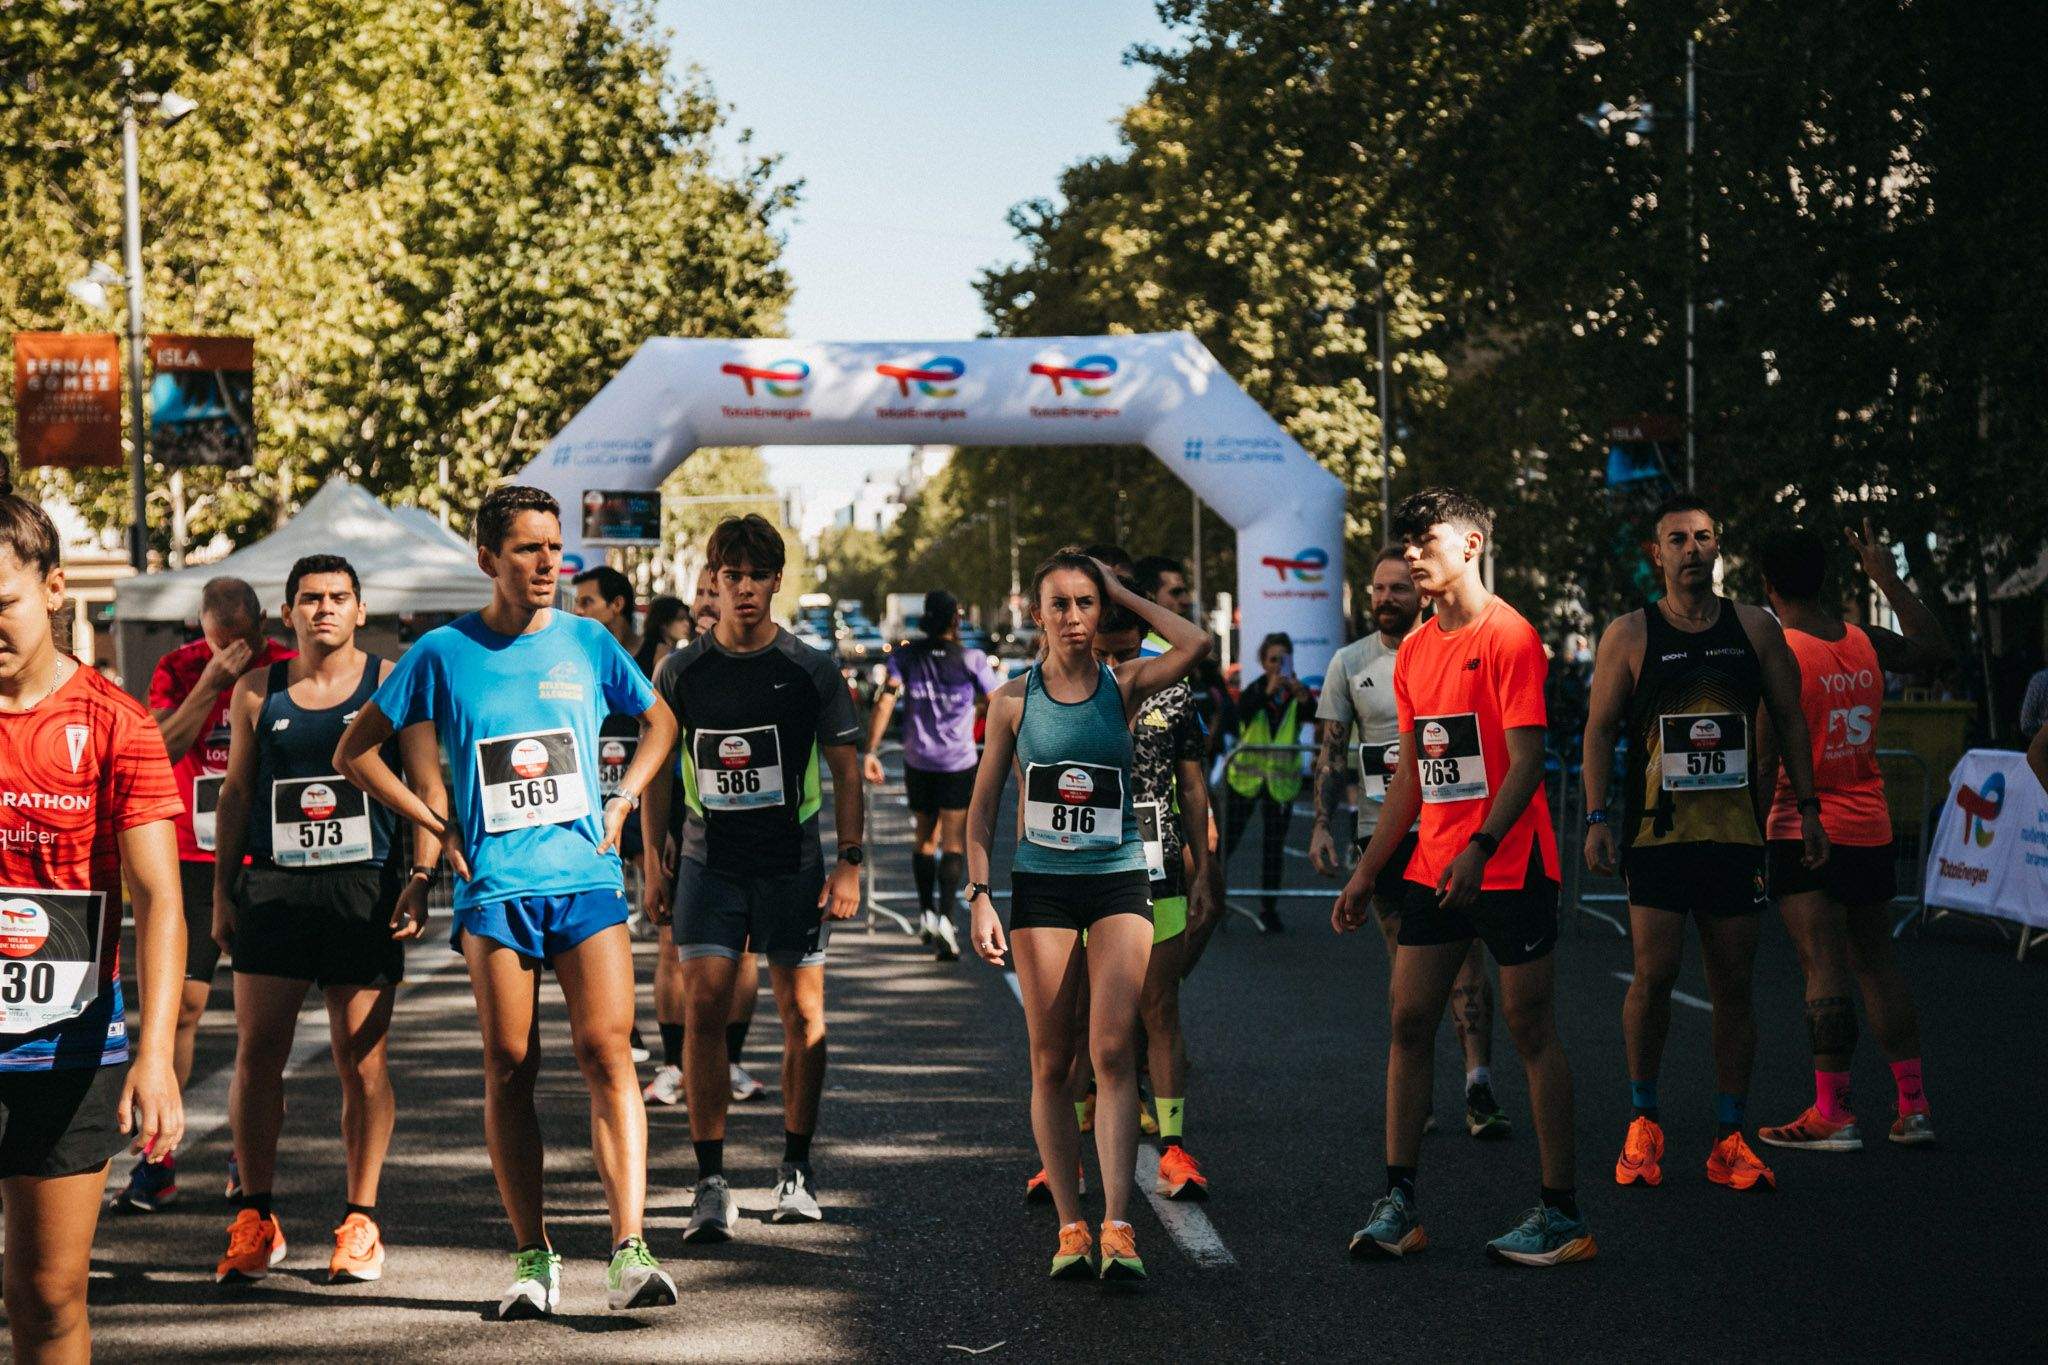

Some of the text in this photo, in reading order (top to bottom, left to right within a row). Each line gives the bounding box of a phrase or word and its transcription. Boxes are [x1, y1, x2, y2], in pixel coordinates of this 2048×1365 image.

[1820, 669, 1873, 693] YOYO
[600, 766, 625, 782] 58
[1423, 759, 1461, 786] 263
[1687, 752, 1726, 775] 576
[510, 778, 559, 809] 569
[717, 769, 760, 794] 586
[0, 792, 91, 810] RATHON
[1052, 805, 1096, 833] 816
[300, 821, 342, 848] 573
[2, 962, 55, 1004] 30
